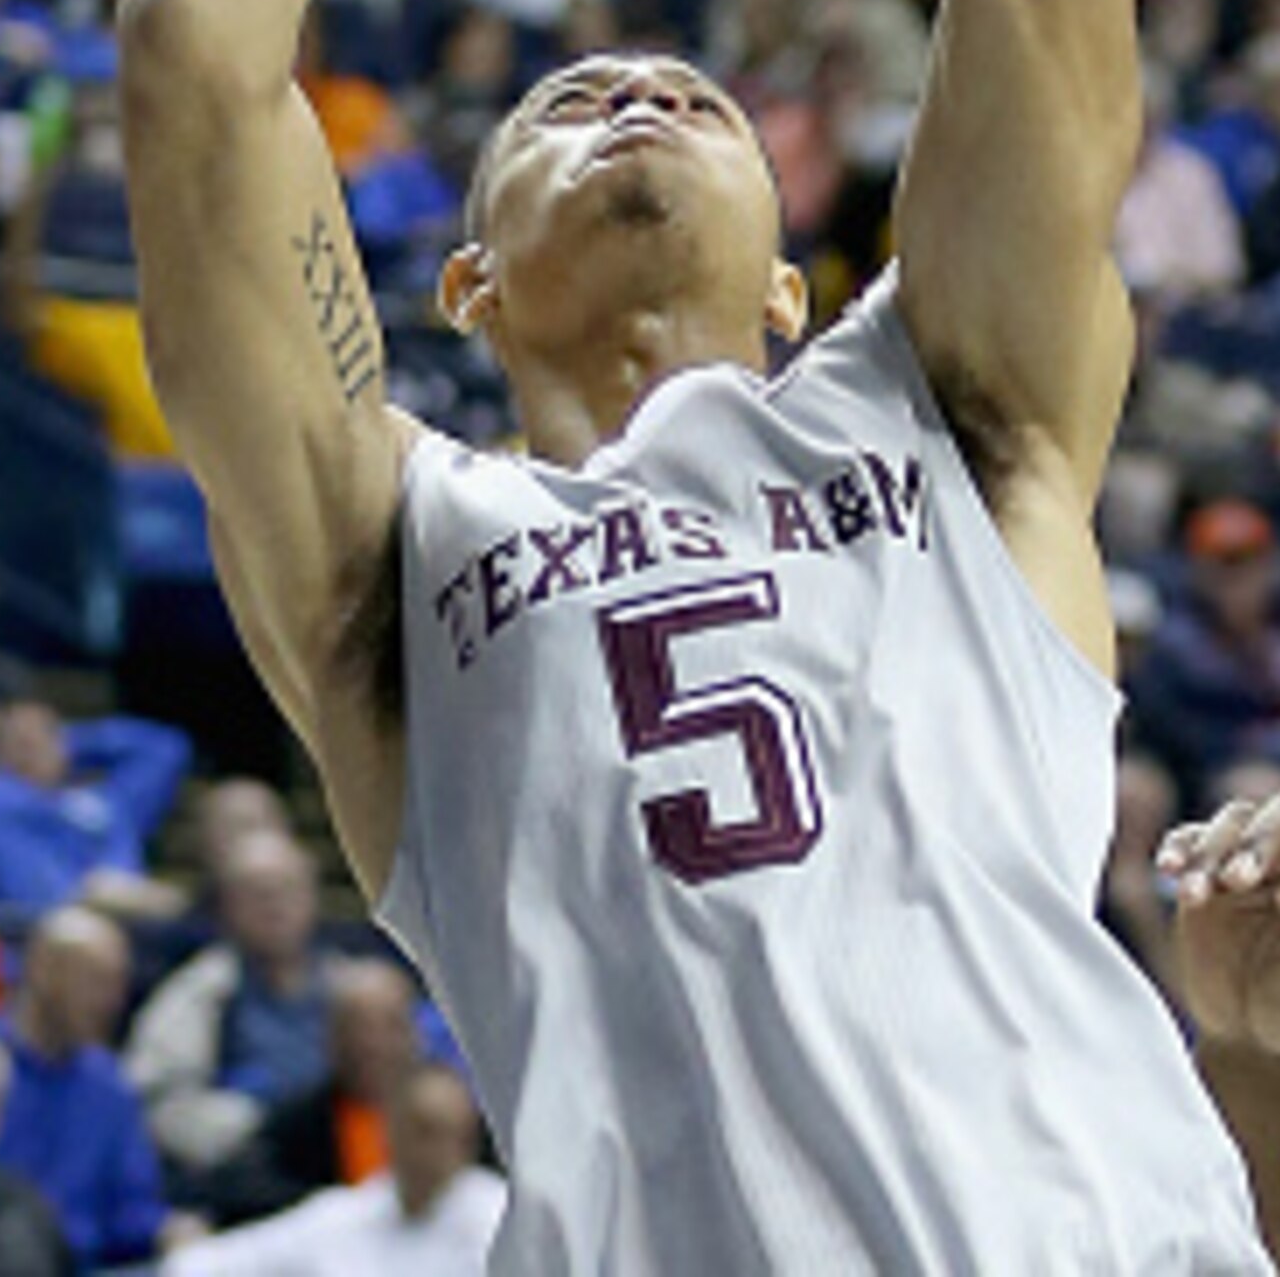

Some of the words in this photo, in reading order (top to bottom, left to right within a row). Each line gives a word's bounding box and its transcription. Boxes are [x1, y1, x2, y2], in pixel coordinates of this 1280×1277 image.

[291, 208, 376, 404] XXIII
[434, 505, 726, 671] TEXAS
[758, 450, 929, 552] A&M
[596, 570, 824, 886] 5
